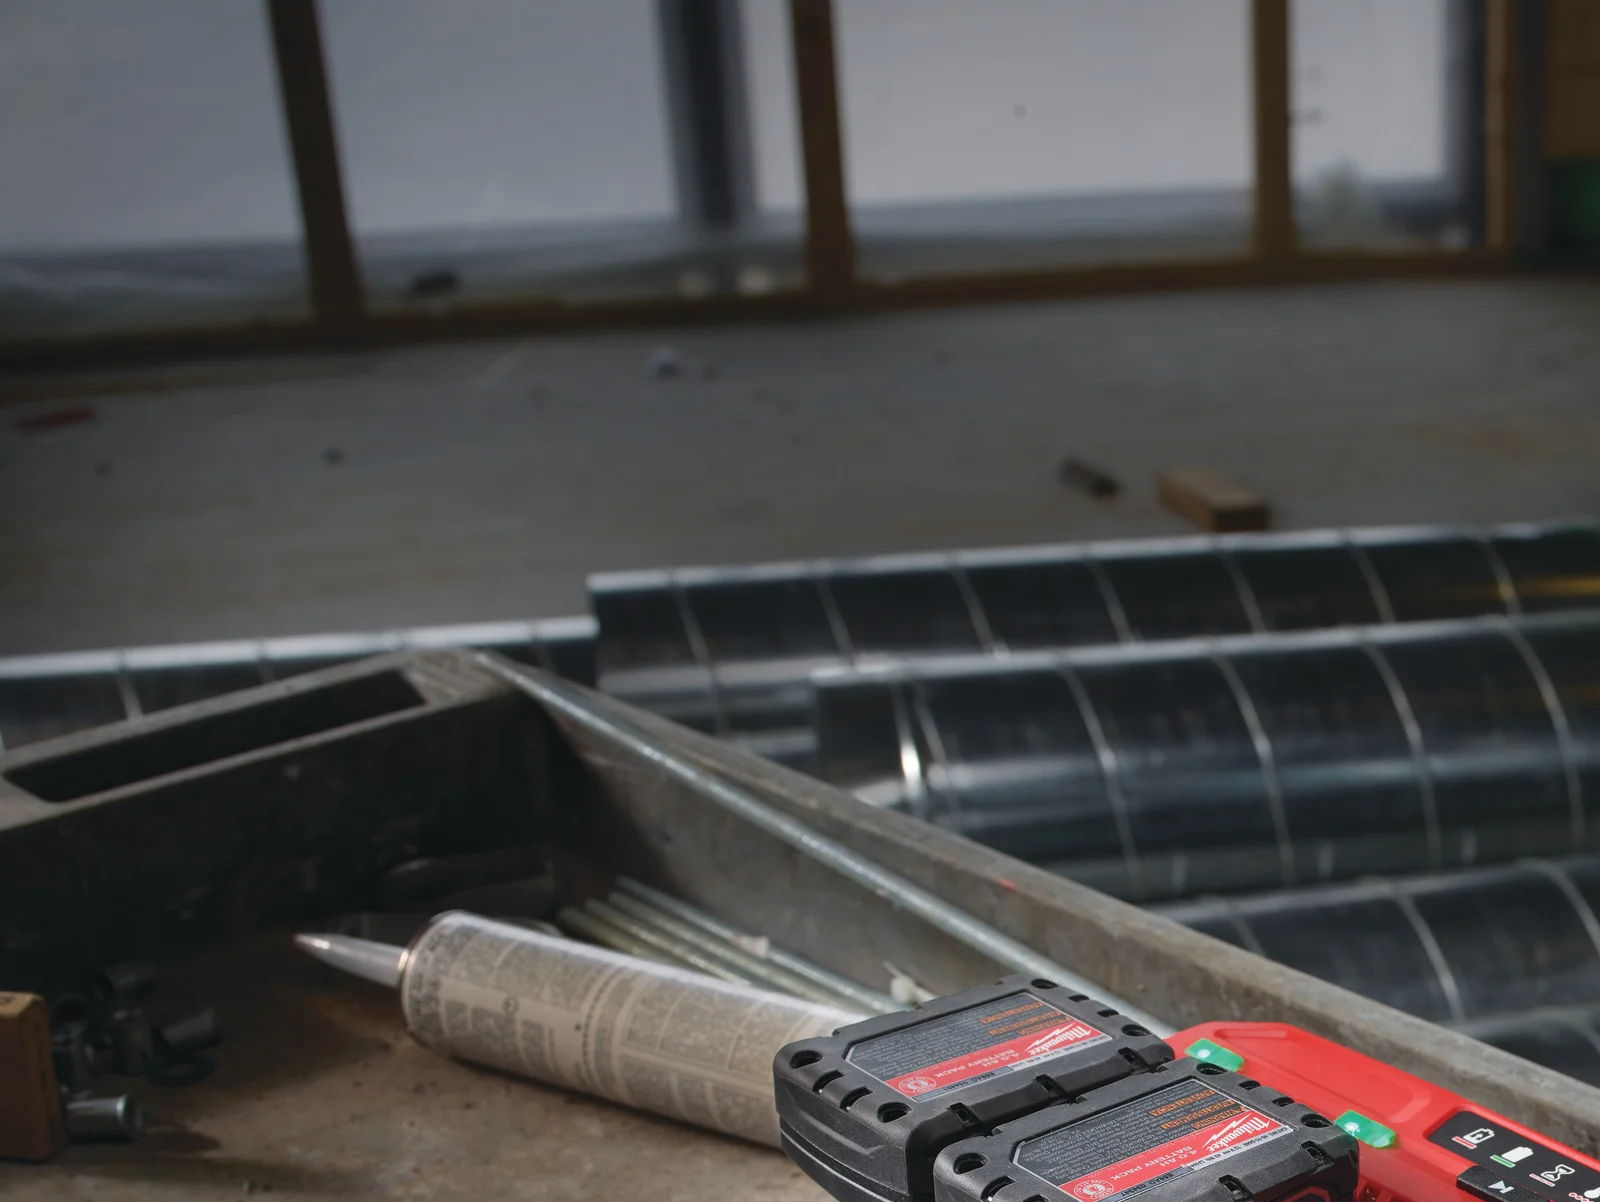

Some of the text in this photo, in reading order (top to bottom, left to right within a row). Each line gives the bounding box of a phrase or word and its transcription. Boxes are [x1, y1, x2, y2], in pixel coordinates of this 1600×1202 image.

[1028, 1025, 1092, 1055] Milwaukee
[967, 1049, 1016, 1068] BATTERY
[935, 1065, 966, 1078] PACK
[1205, 1116, 1270, 1151] Milwaukee
[1110, 1145, 1193, 1181] BATTERY PACK
[1160, 1148, 1197, 1167] 4.0 AH
